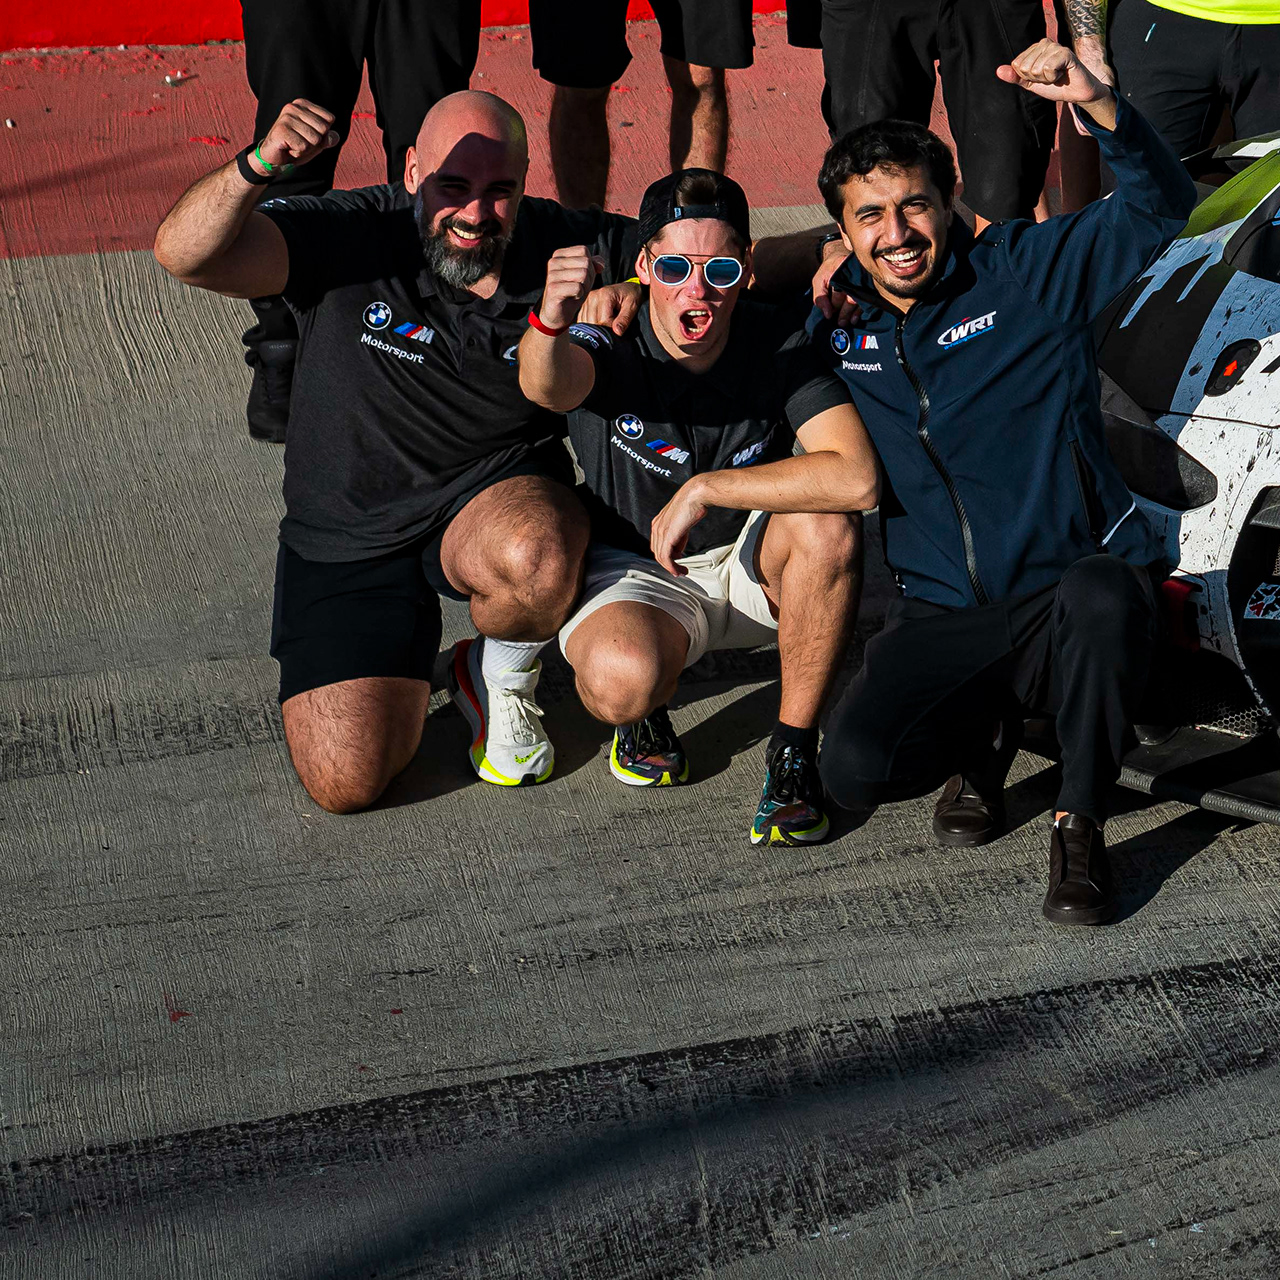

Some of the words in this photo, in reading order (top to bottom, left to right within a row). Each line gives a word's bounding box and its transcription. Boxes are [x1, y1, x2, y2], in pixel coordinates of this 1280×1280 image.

[950, 310, 998, 343] WRT
[360, 332, 425, 364] Motorsport
[842, 360, 883, 373] Motorsport
[610, 434, 673, 478] Motorsport
